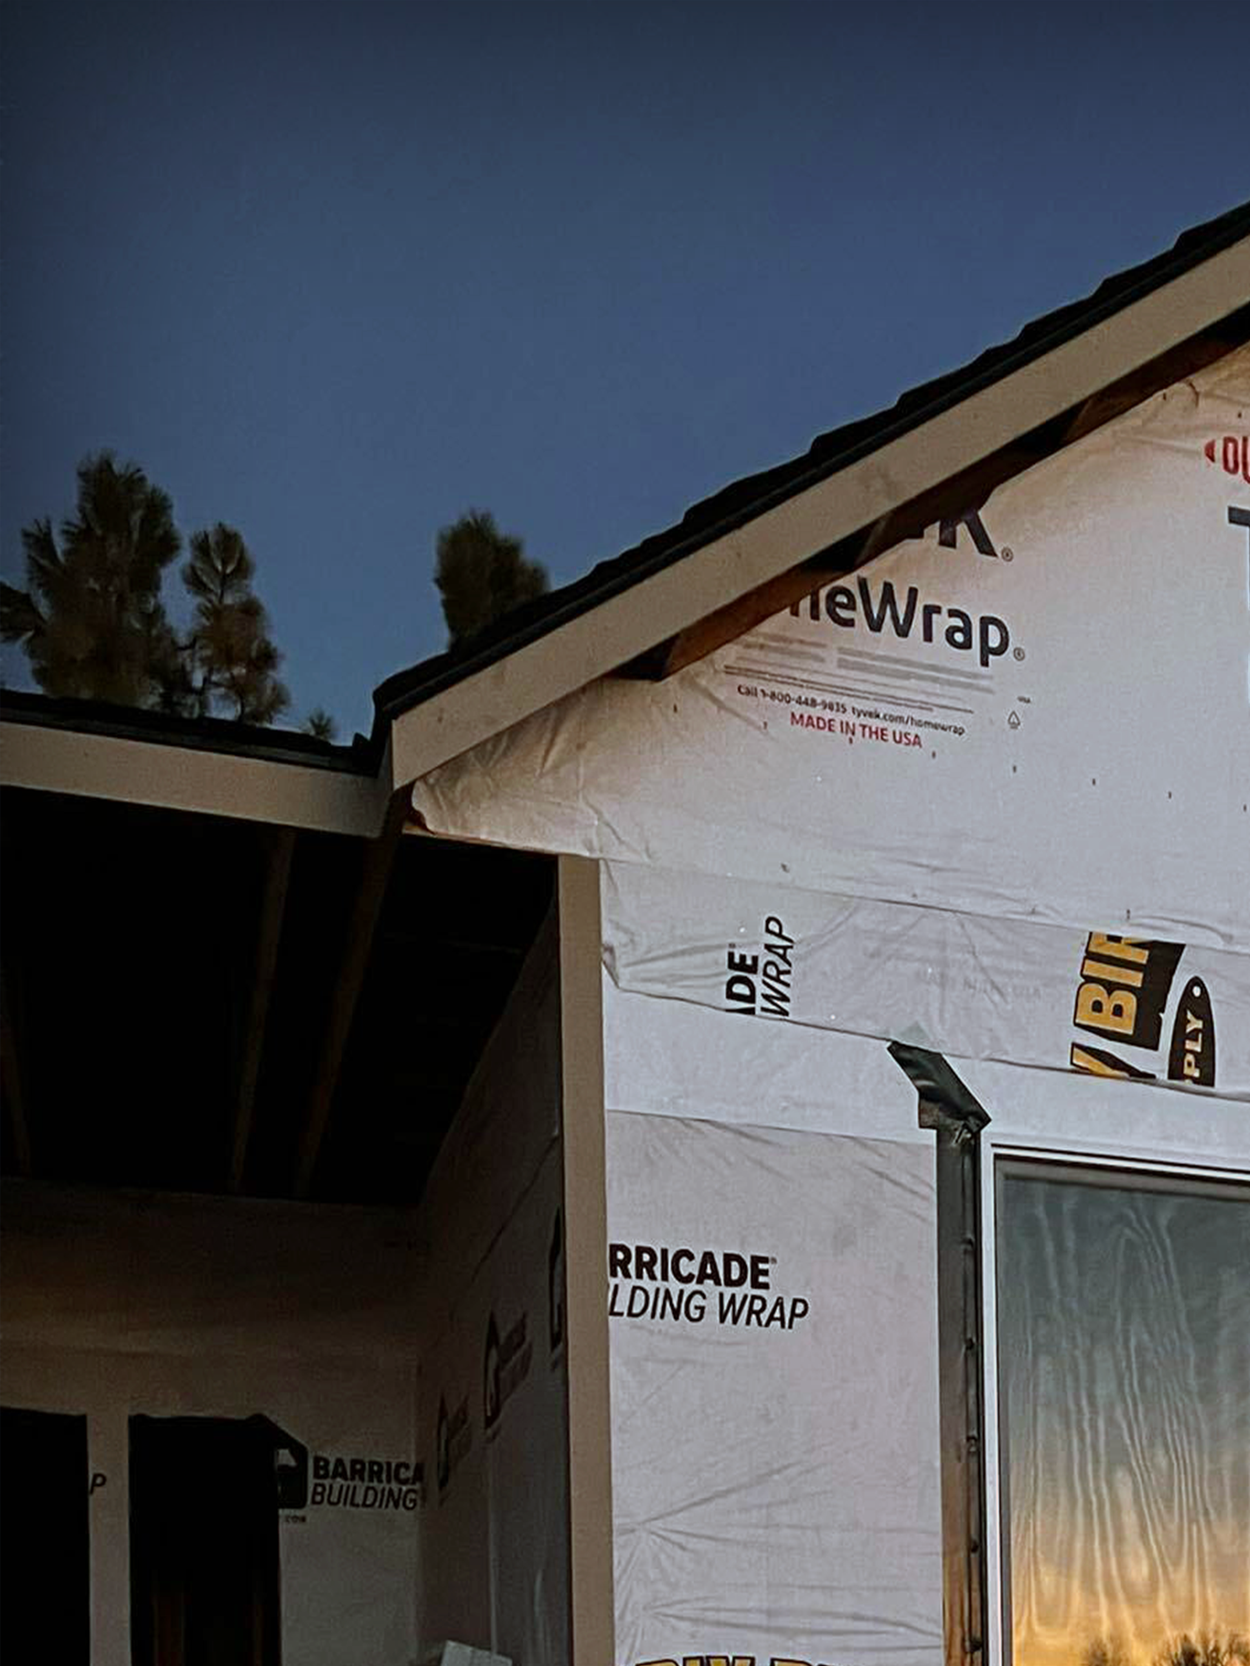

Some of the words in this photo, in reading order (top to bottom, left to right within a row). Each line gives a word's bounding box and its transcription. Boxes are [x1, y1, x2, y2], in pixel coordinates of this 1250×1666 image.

[790, 711, 836, 732] MADE
[839, 720, 856, 737] IN
[859, 723, 889, 742] THE
[892, 731, 923, 748] USA
[760, 916, 794, 1017] WRAP
[609, 1243, 770, 1290] RRICADE
[609, 1284, 707, 1323] LDING
[718, 1291, 809, 1330] WRAP
[311, 1483, 418, 1511] BUILDING
